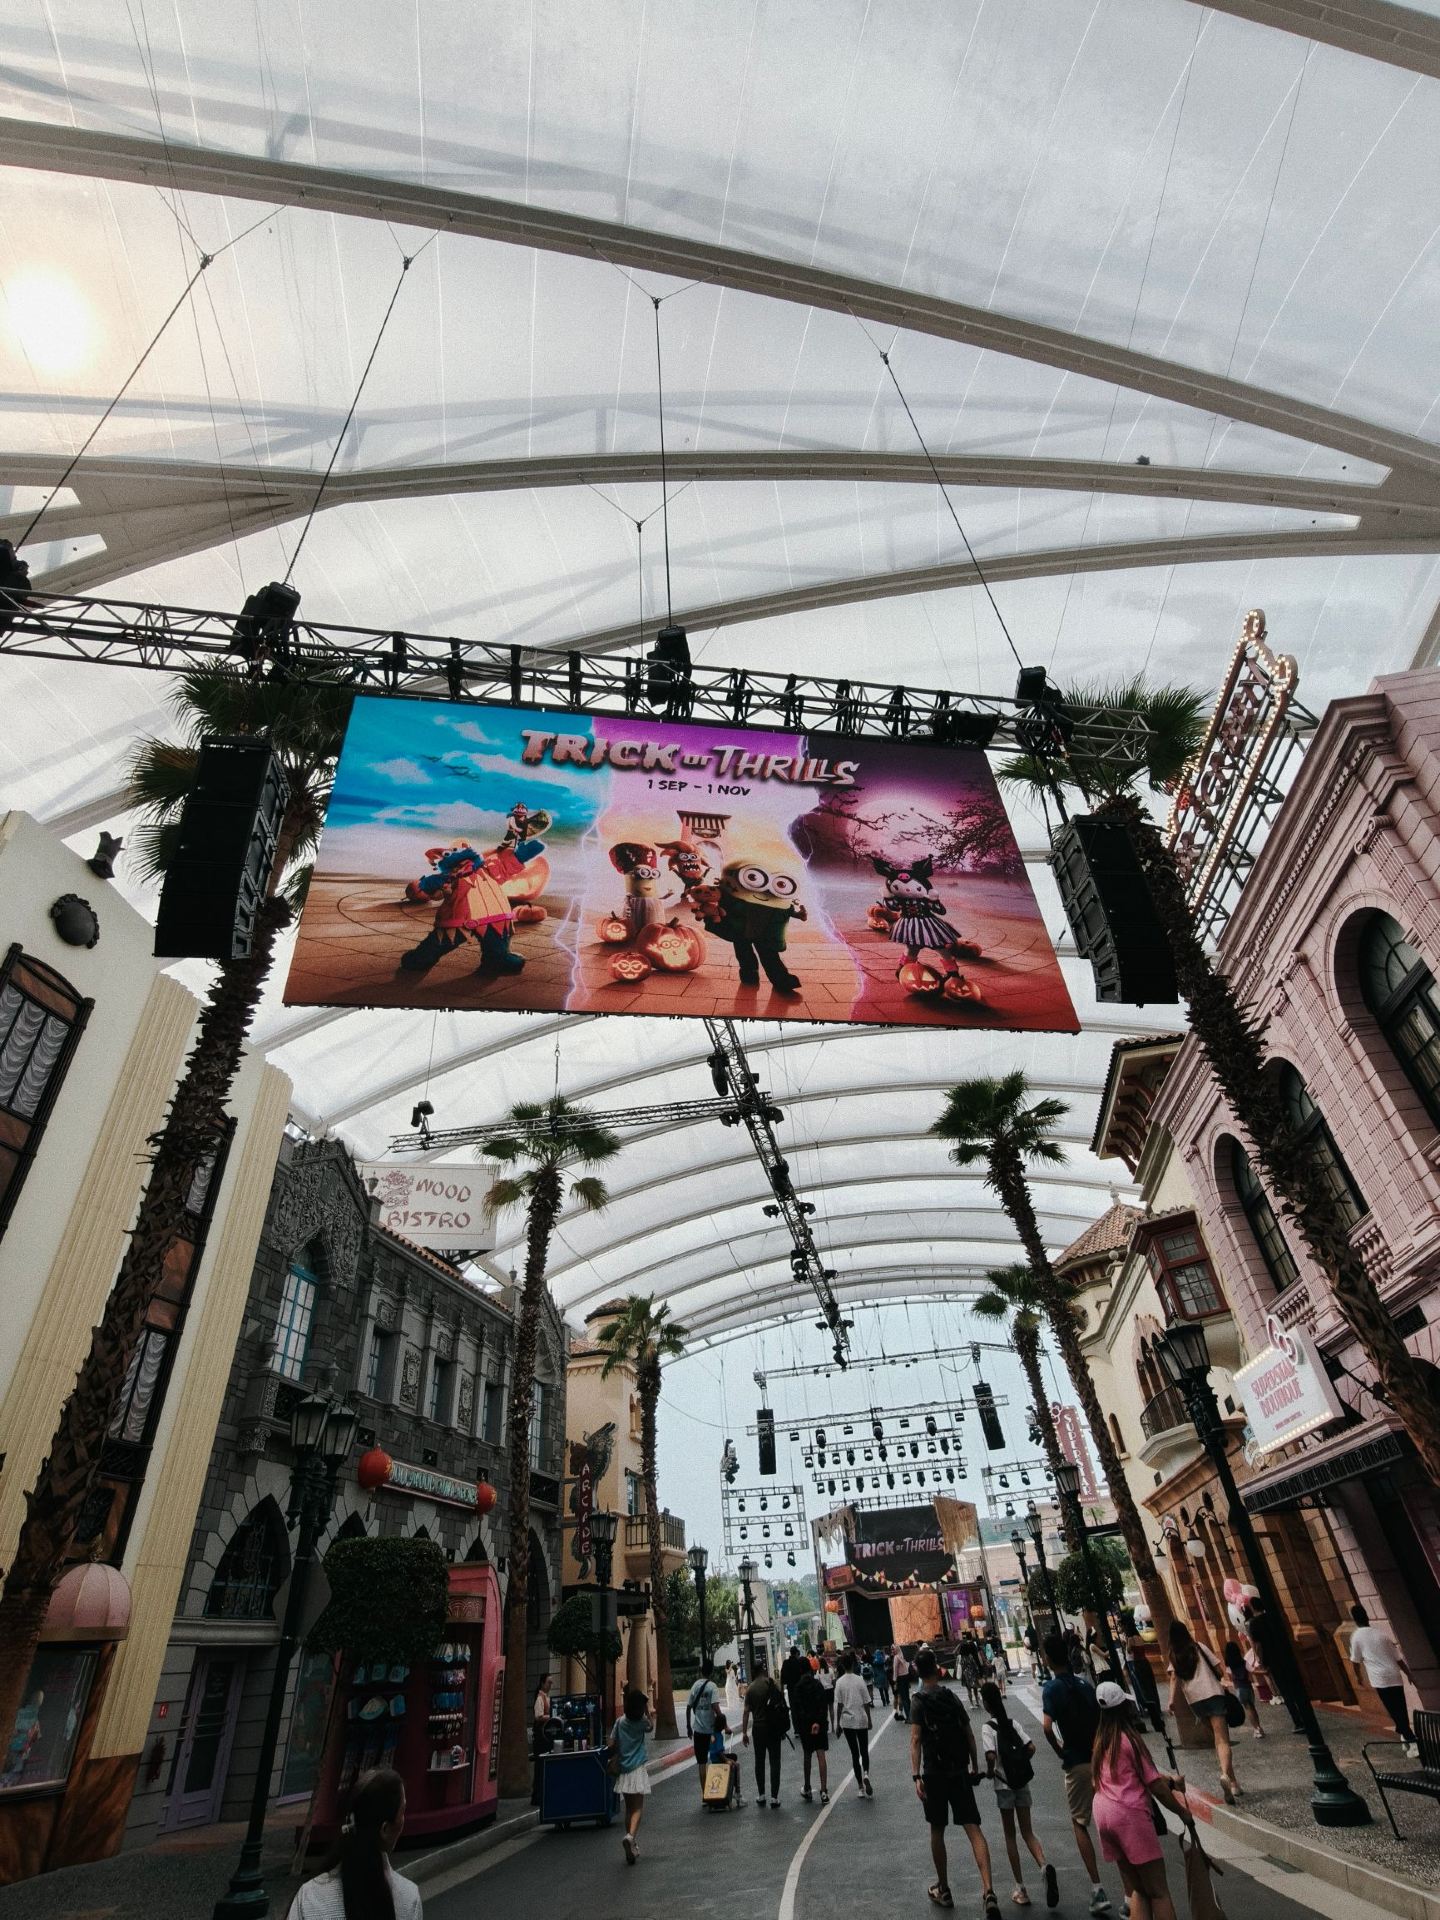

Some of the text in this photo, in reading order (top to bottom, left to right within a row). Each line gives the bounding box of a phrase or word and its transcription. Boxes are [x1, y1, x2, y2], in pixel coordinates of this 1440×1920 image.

[521, 729, 861, 786] TRICK or THRILLS
[647, 779, 653, 789] 1
[658, 780, 688, 791] SEP
[707, 783, 713, 794] 1
[718, 784, 751, 796] NOV
[387, 1211, 471, 1228] BISTRO
[853, 1541, 895, 1560] TRICK
[903, 1537, 944, 1553] THRILLS
